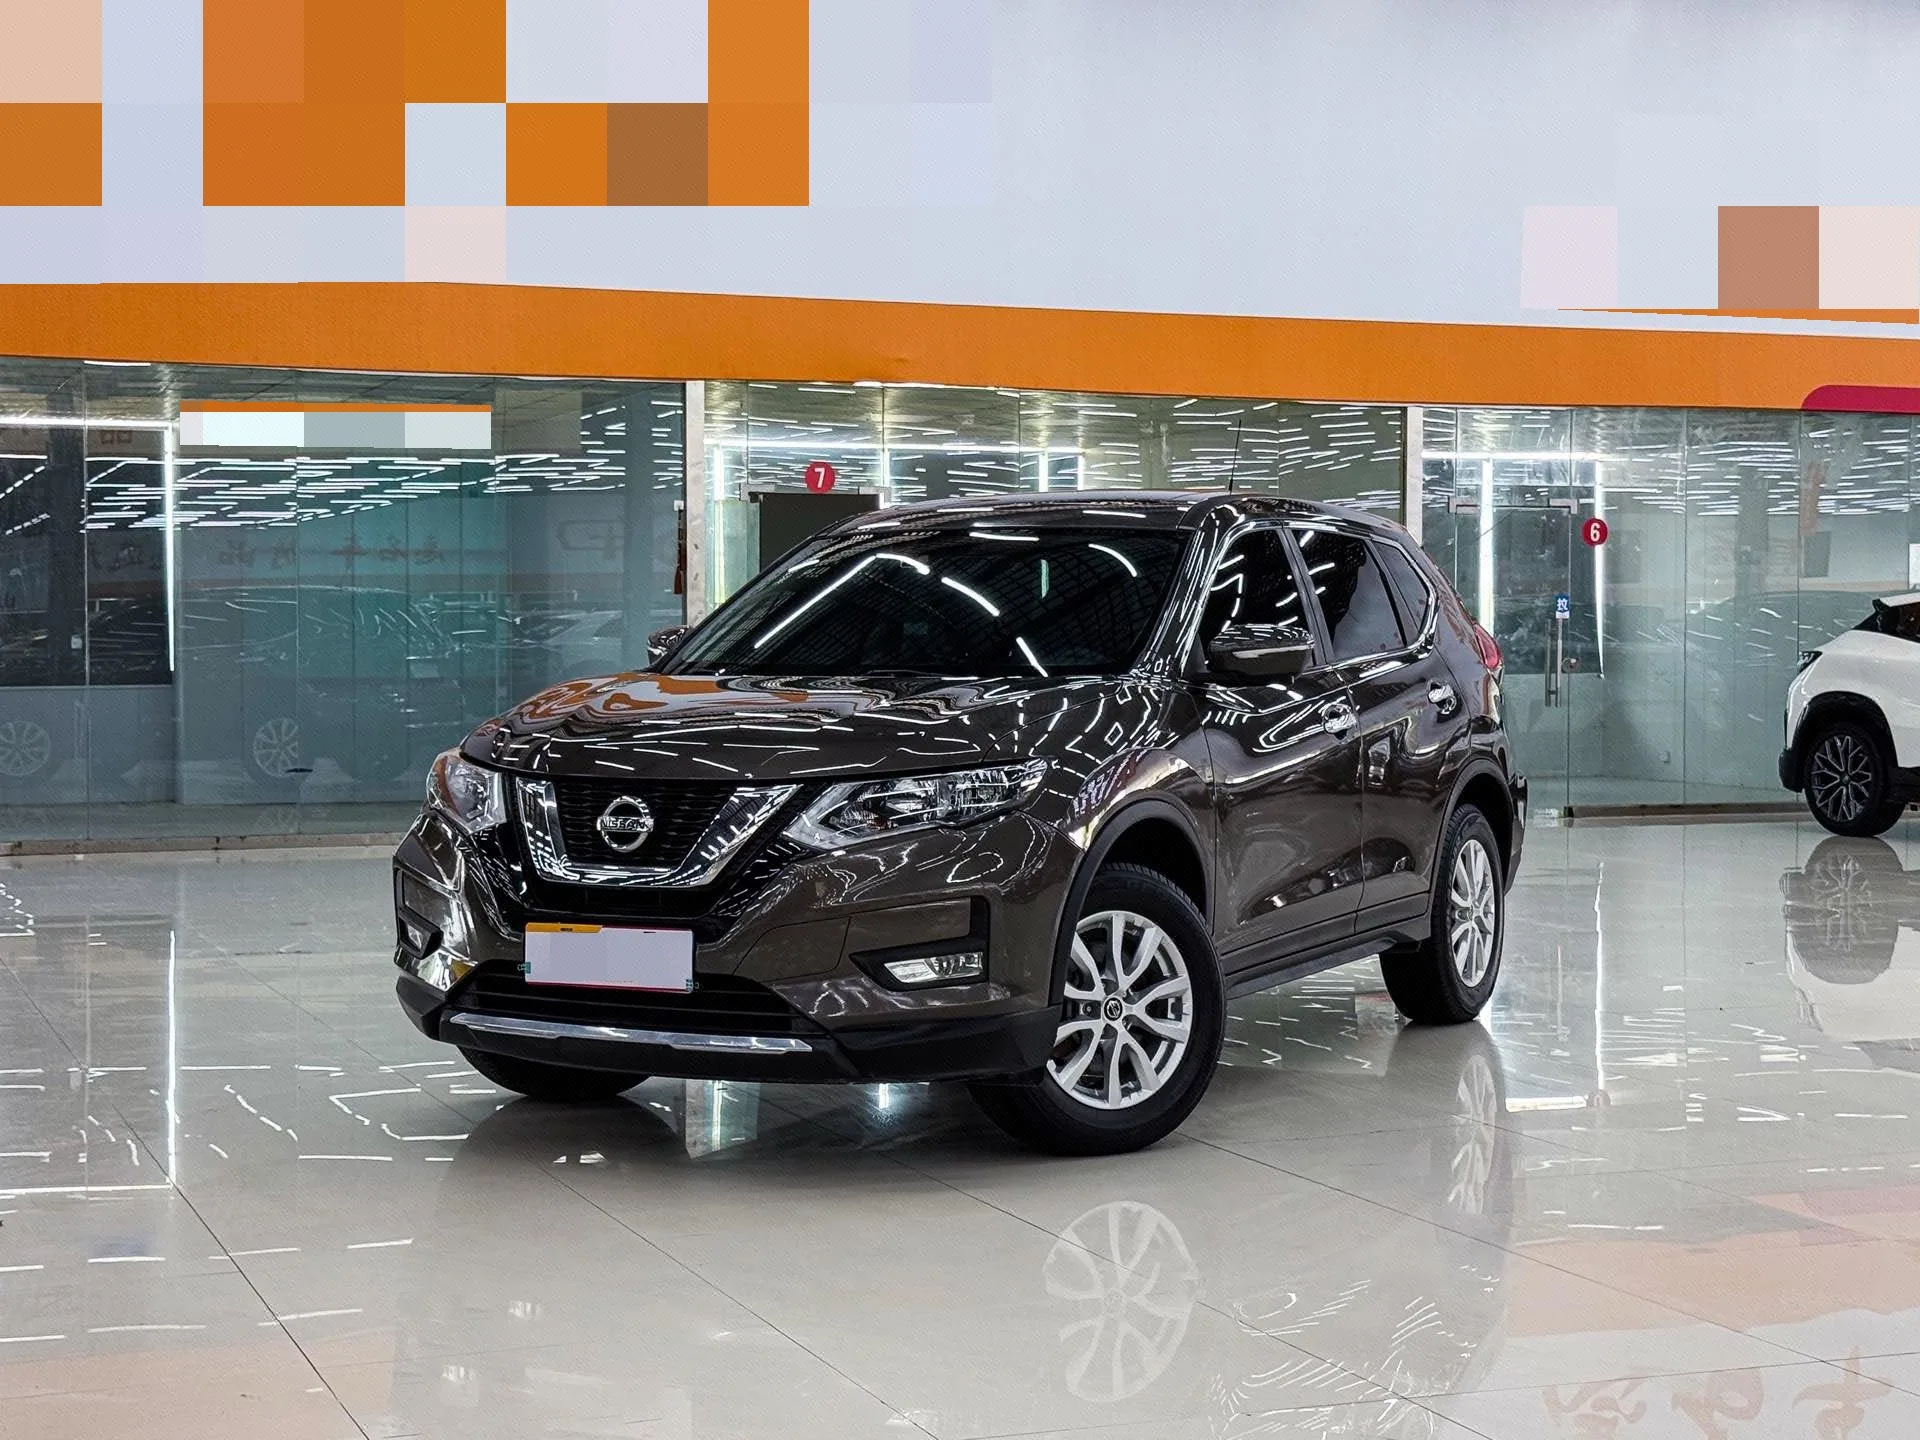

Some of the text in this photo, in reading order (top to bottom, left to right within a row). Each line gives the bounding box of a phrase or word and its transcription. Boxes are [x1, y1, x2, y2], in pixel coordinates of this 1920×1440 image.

[814, 467, 826, 489] 7
[1590, 522, 1601, 542] 6
[1556, 597, 1569, 611] 拉
[600, 817, 651, 831] NISSAN
